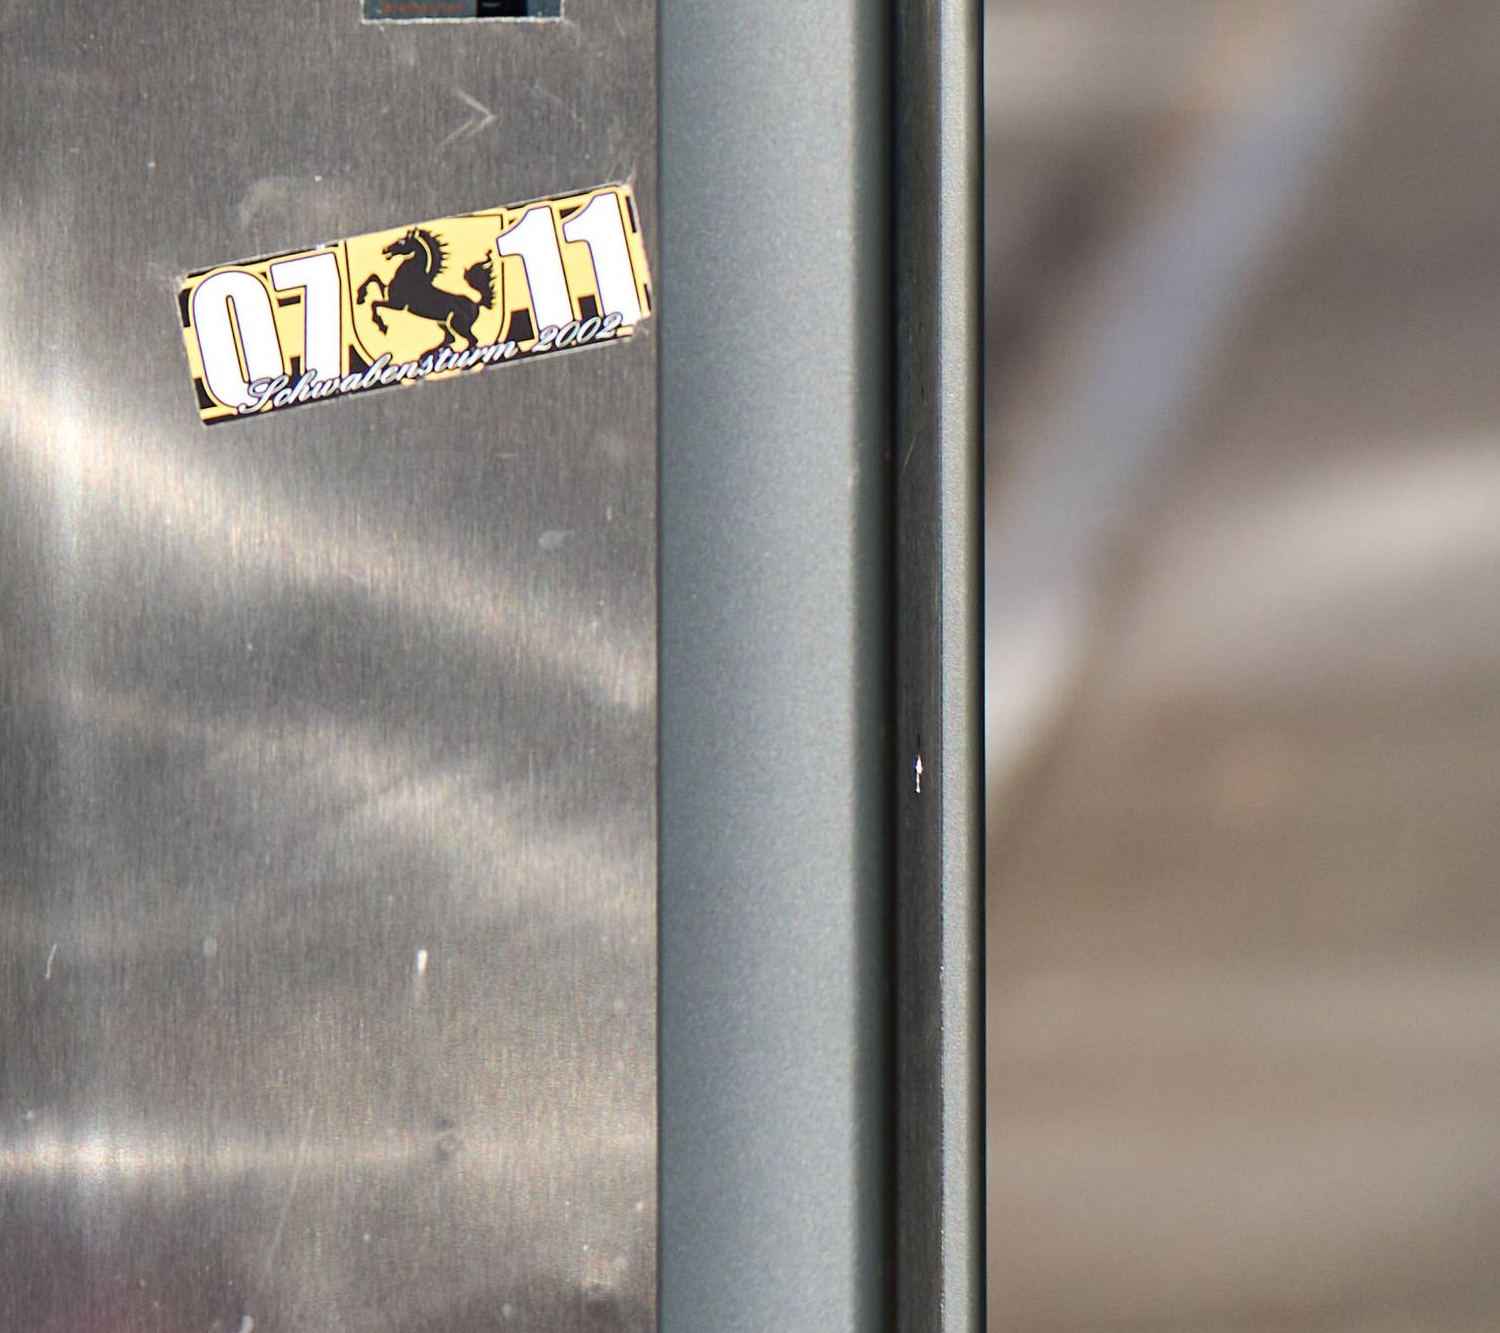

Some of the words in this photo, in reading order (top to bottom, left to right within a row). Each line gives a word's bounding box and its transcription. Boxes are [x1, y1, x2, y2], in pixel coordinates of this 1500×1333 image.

[192, 250, 342, 409] 07
[497, 192, 642, 331] 11
[237, 338, 518, 414] Schwabensturm
[531, 311, 624, 353] 2002
